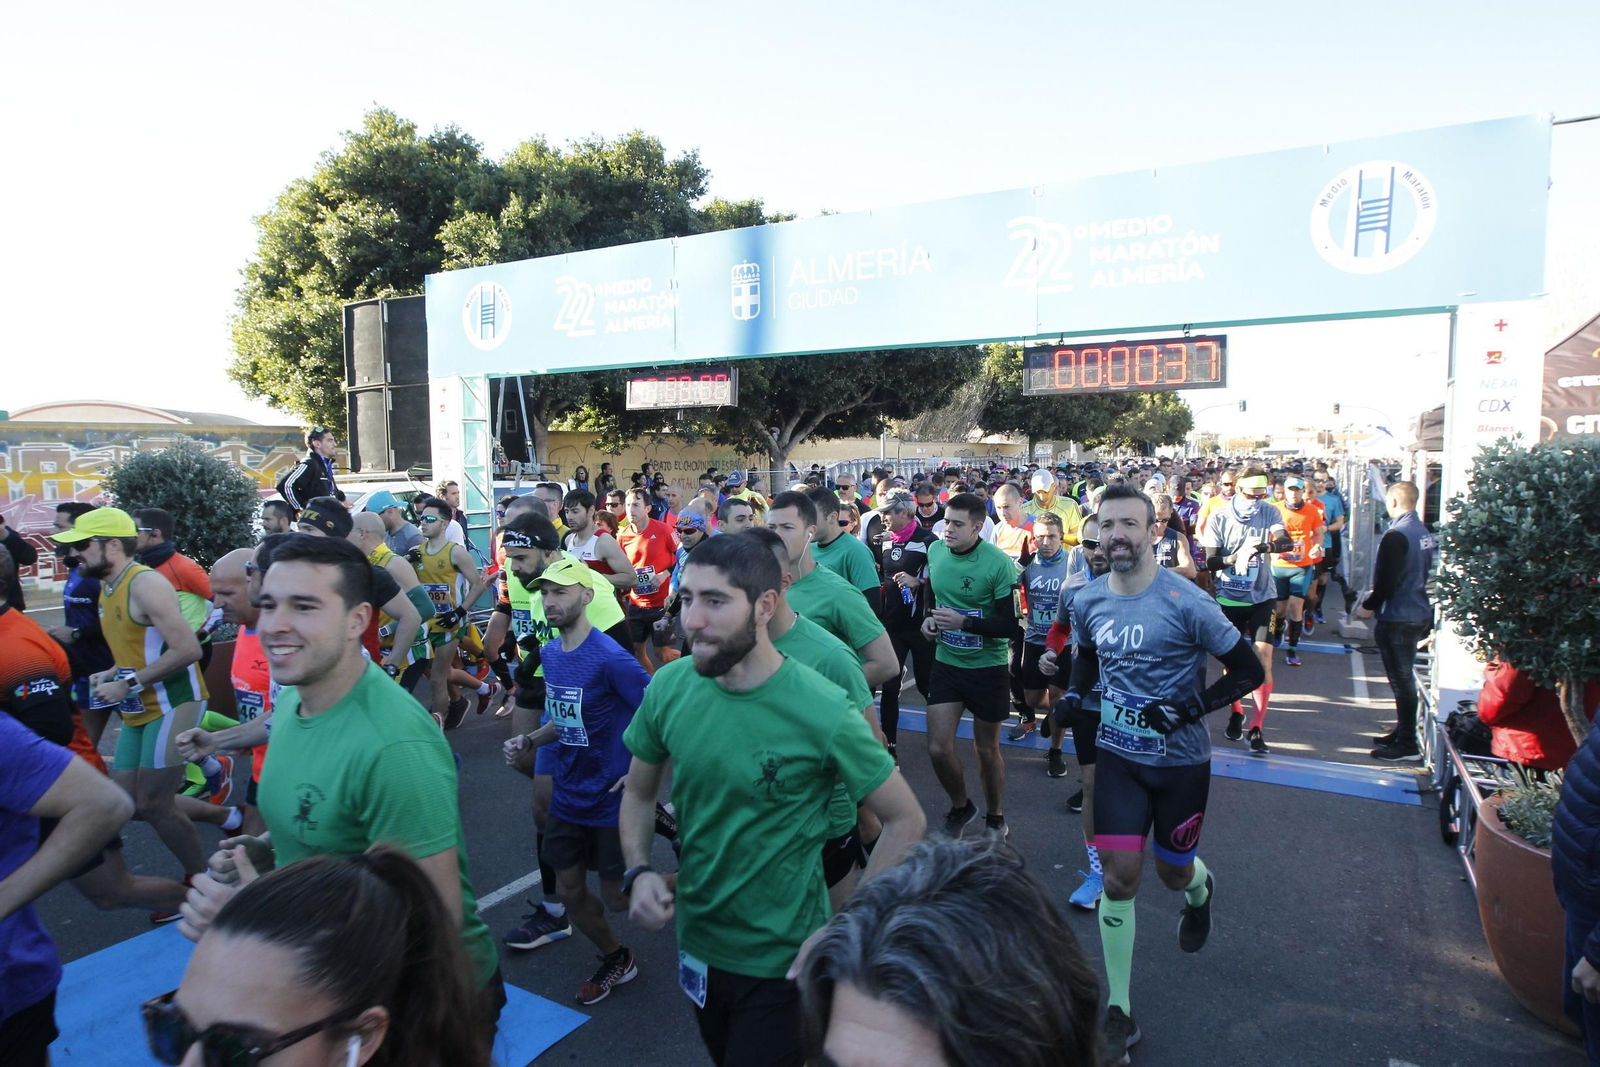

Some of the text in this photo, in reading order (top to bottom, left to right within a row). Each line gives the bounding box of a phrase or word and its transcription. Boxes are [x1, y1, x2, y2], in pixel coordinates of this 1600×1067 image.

[1090, 231, 1221, 265] MARATÓN
[788, 238, 932, 287] ALMERÍA
[1090, 258, 1205, 289] ALMERÍA
[604, 290, 680, 316] MARATÓN
[787, 286, 858, 311] CIUDAD
[605, 313, 672, 334] ALMERÍA
[1054, 340, 1218, 389] 00:00:37
[1478, 399, 1512, 413] CDX
[1477, 424, 1515, 433] Blanes
[674, 460, 682, 471] EL
[1091, 619, 1144, 650] a10
[548, 700, 577, 720] 1164
[1113, 704, 1150, 730] 758
